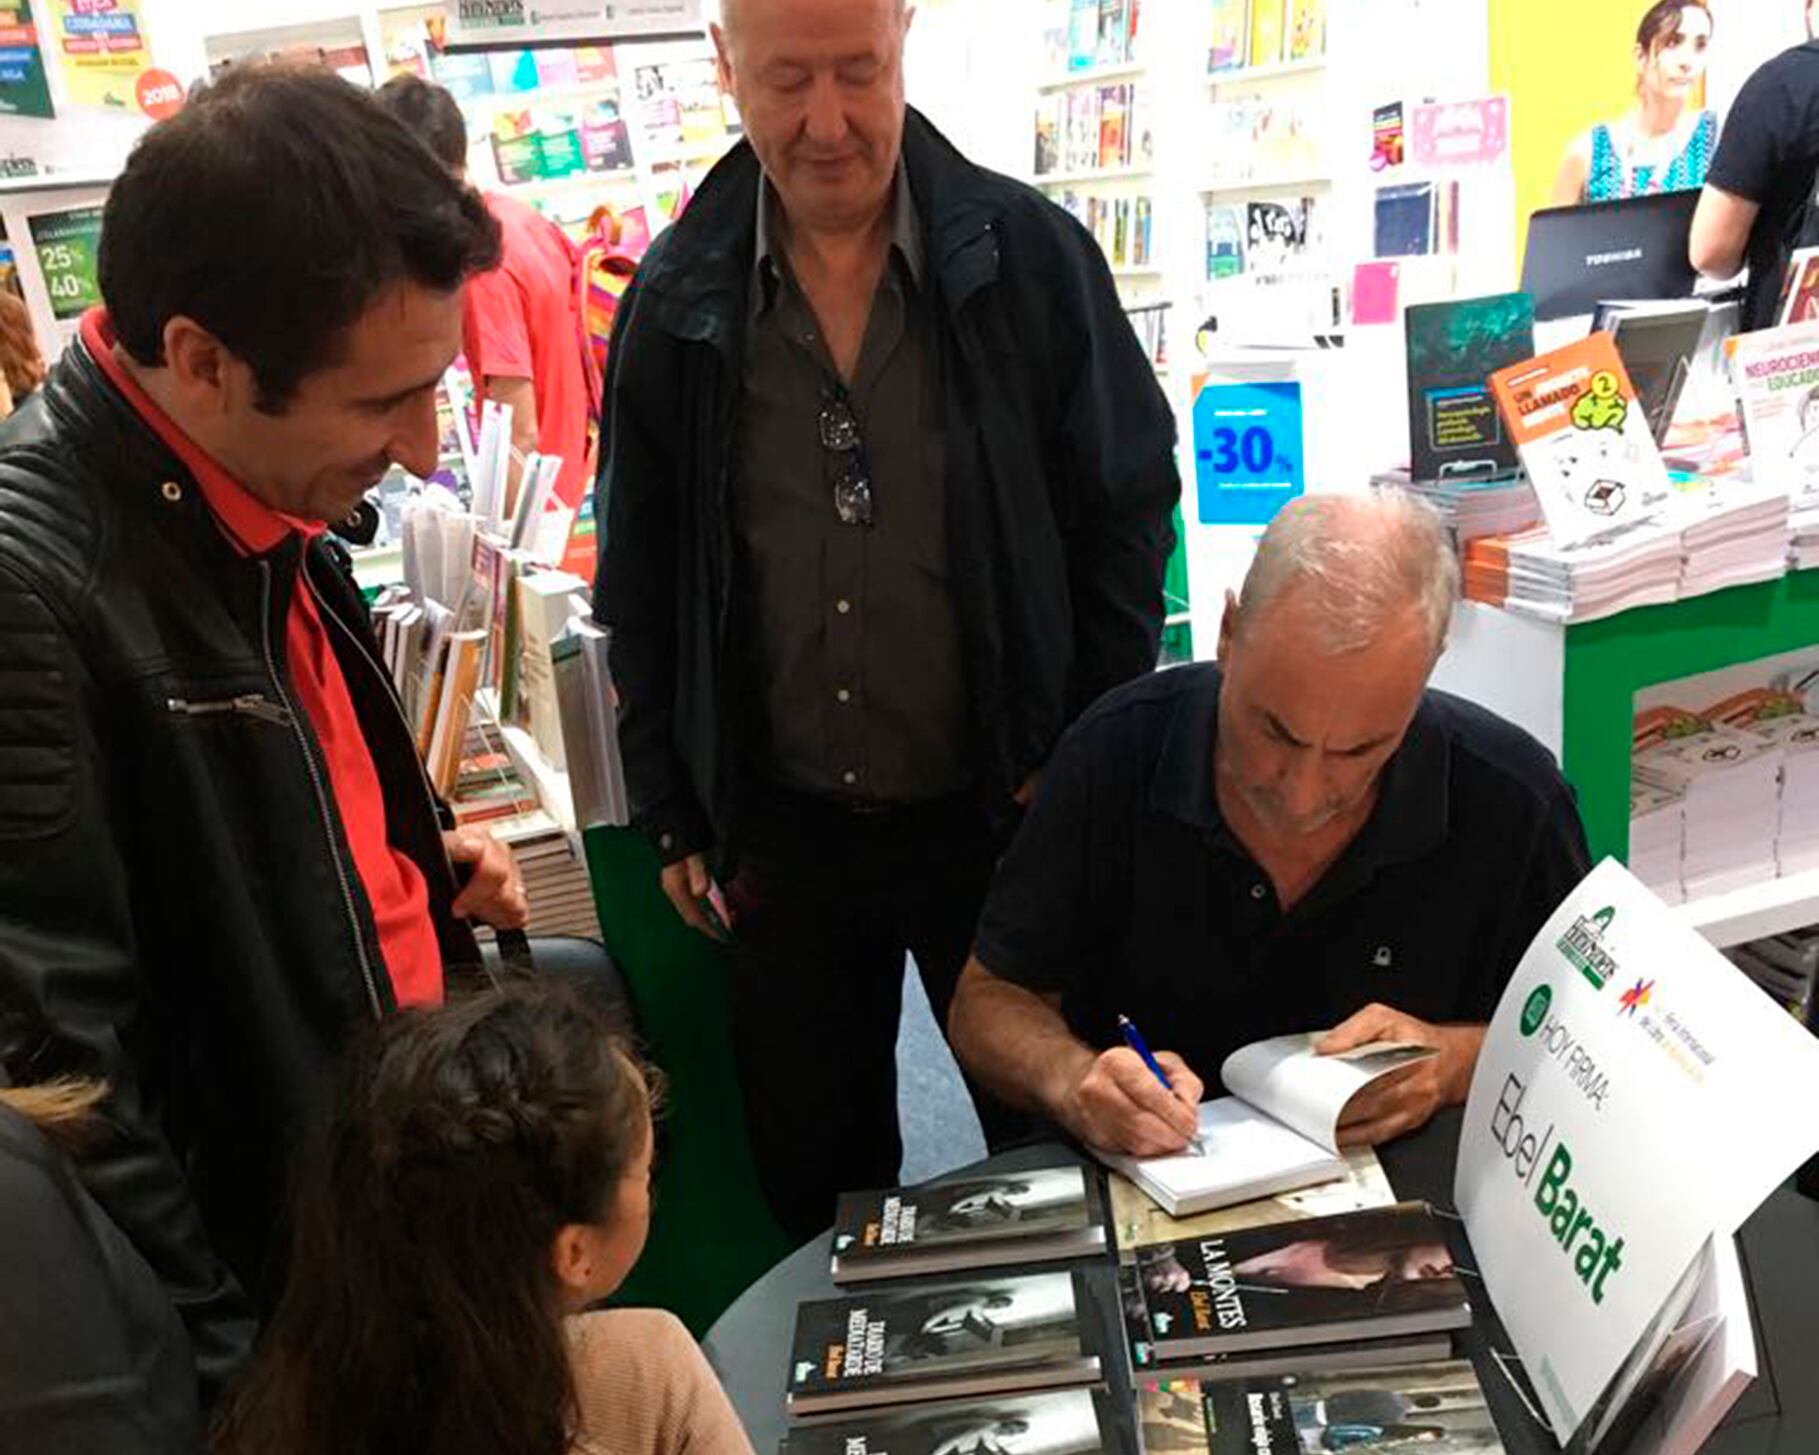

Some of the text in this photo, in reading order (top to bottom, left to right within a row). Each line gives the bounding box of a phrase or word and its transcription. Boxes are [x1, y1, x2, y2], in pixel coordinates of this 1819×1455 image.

[1586, 247, 1642, 266] TOSHIBA
[1518, 383, 1580, 416] LLAMADO
[1598, 376, 1611, 393] 2
[1539, 1014, 1575, 1061] HOY
[1491, 1072, 1554, 1187] Ebel
[1534, 1142, 1625, 1306] Barat
[1201, 1239, 1248, 1328] LA MONTES
